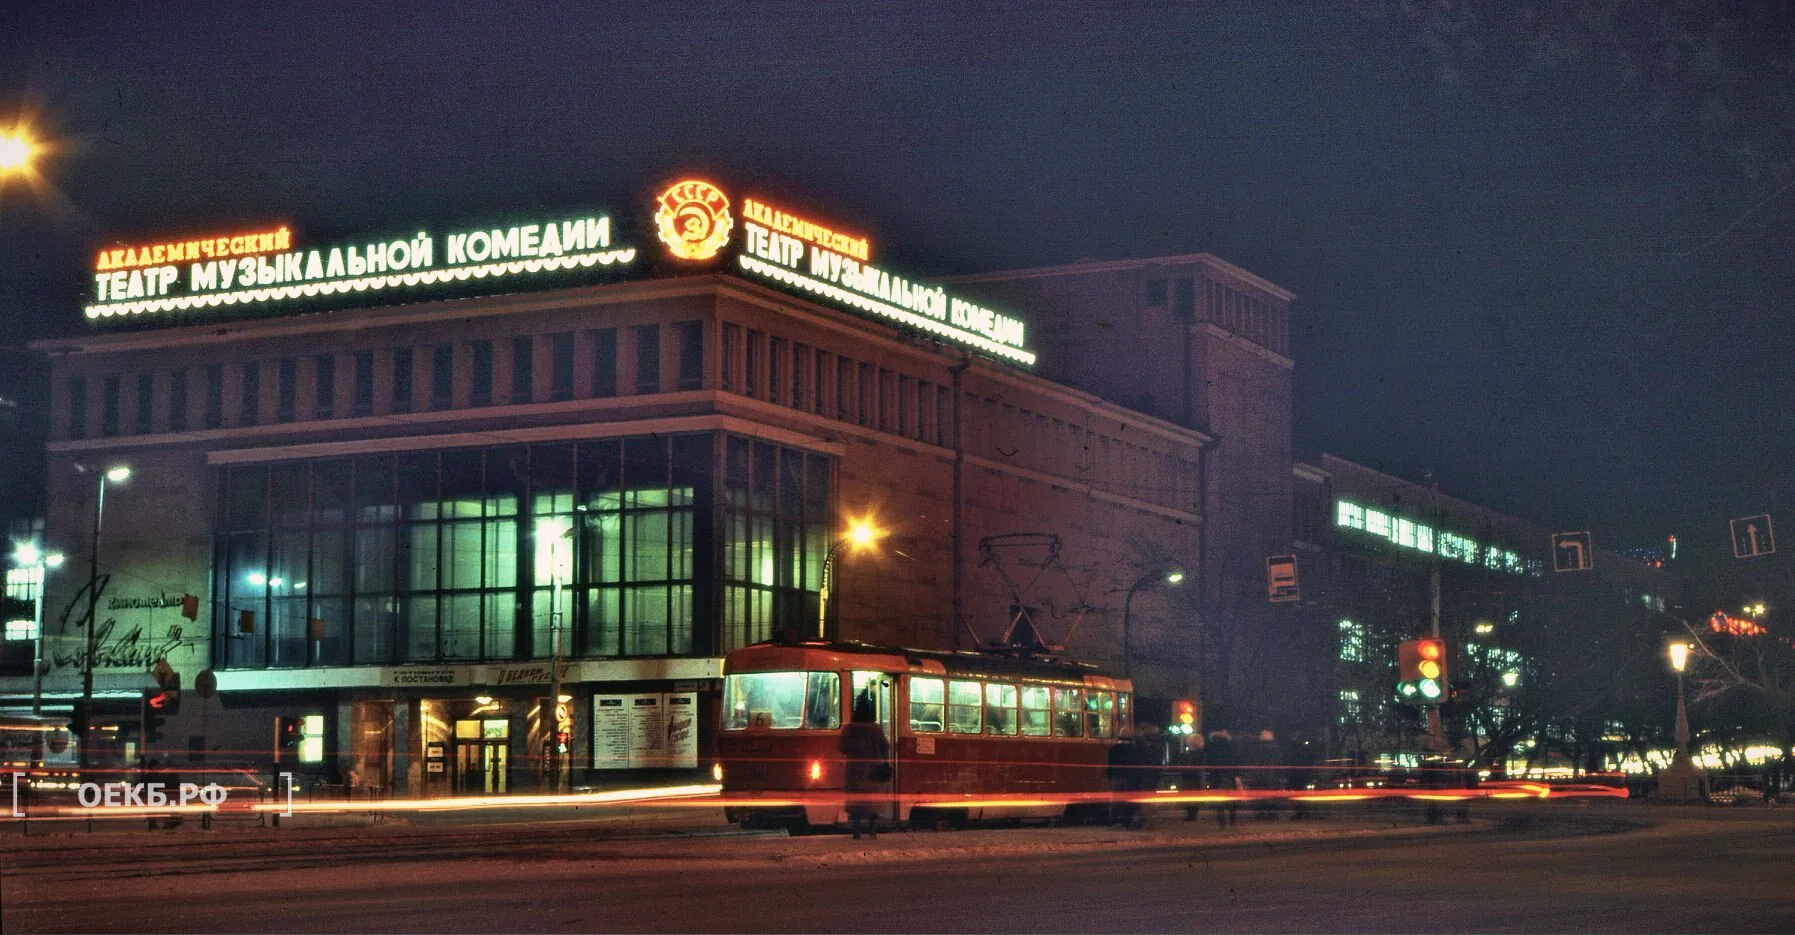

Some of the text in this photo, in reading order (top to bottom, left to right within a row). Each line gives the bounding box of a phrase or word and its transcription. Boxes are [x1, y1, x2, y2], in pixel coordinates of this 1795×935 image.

[671, 184, 720, 203] СССР
[96, 216, 610, 301] ТЕАТР МУЗЫКАЛЬНОЙ КОМЕДИИ
[97, 226, 291, 270] АКАДЕМИЧЕСКИЙ
[743, 199, 869, 261] АКАДЕМИЧЕСКИЙ
[745, 222, 1025, 347] ТЕАТР МУЗЫКАЛЬНОЙ КОМЕДИИ
